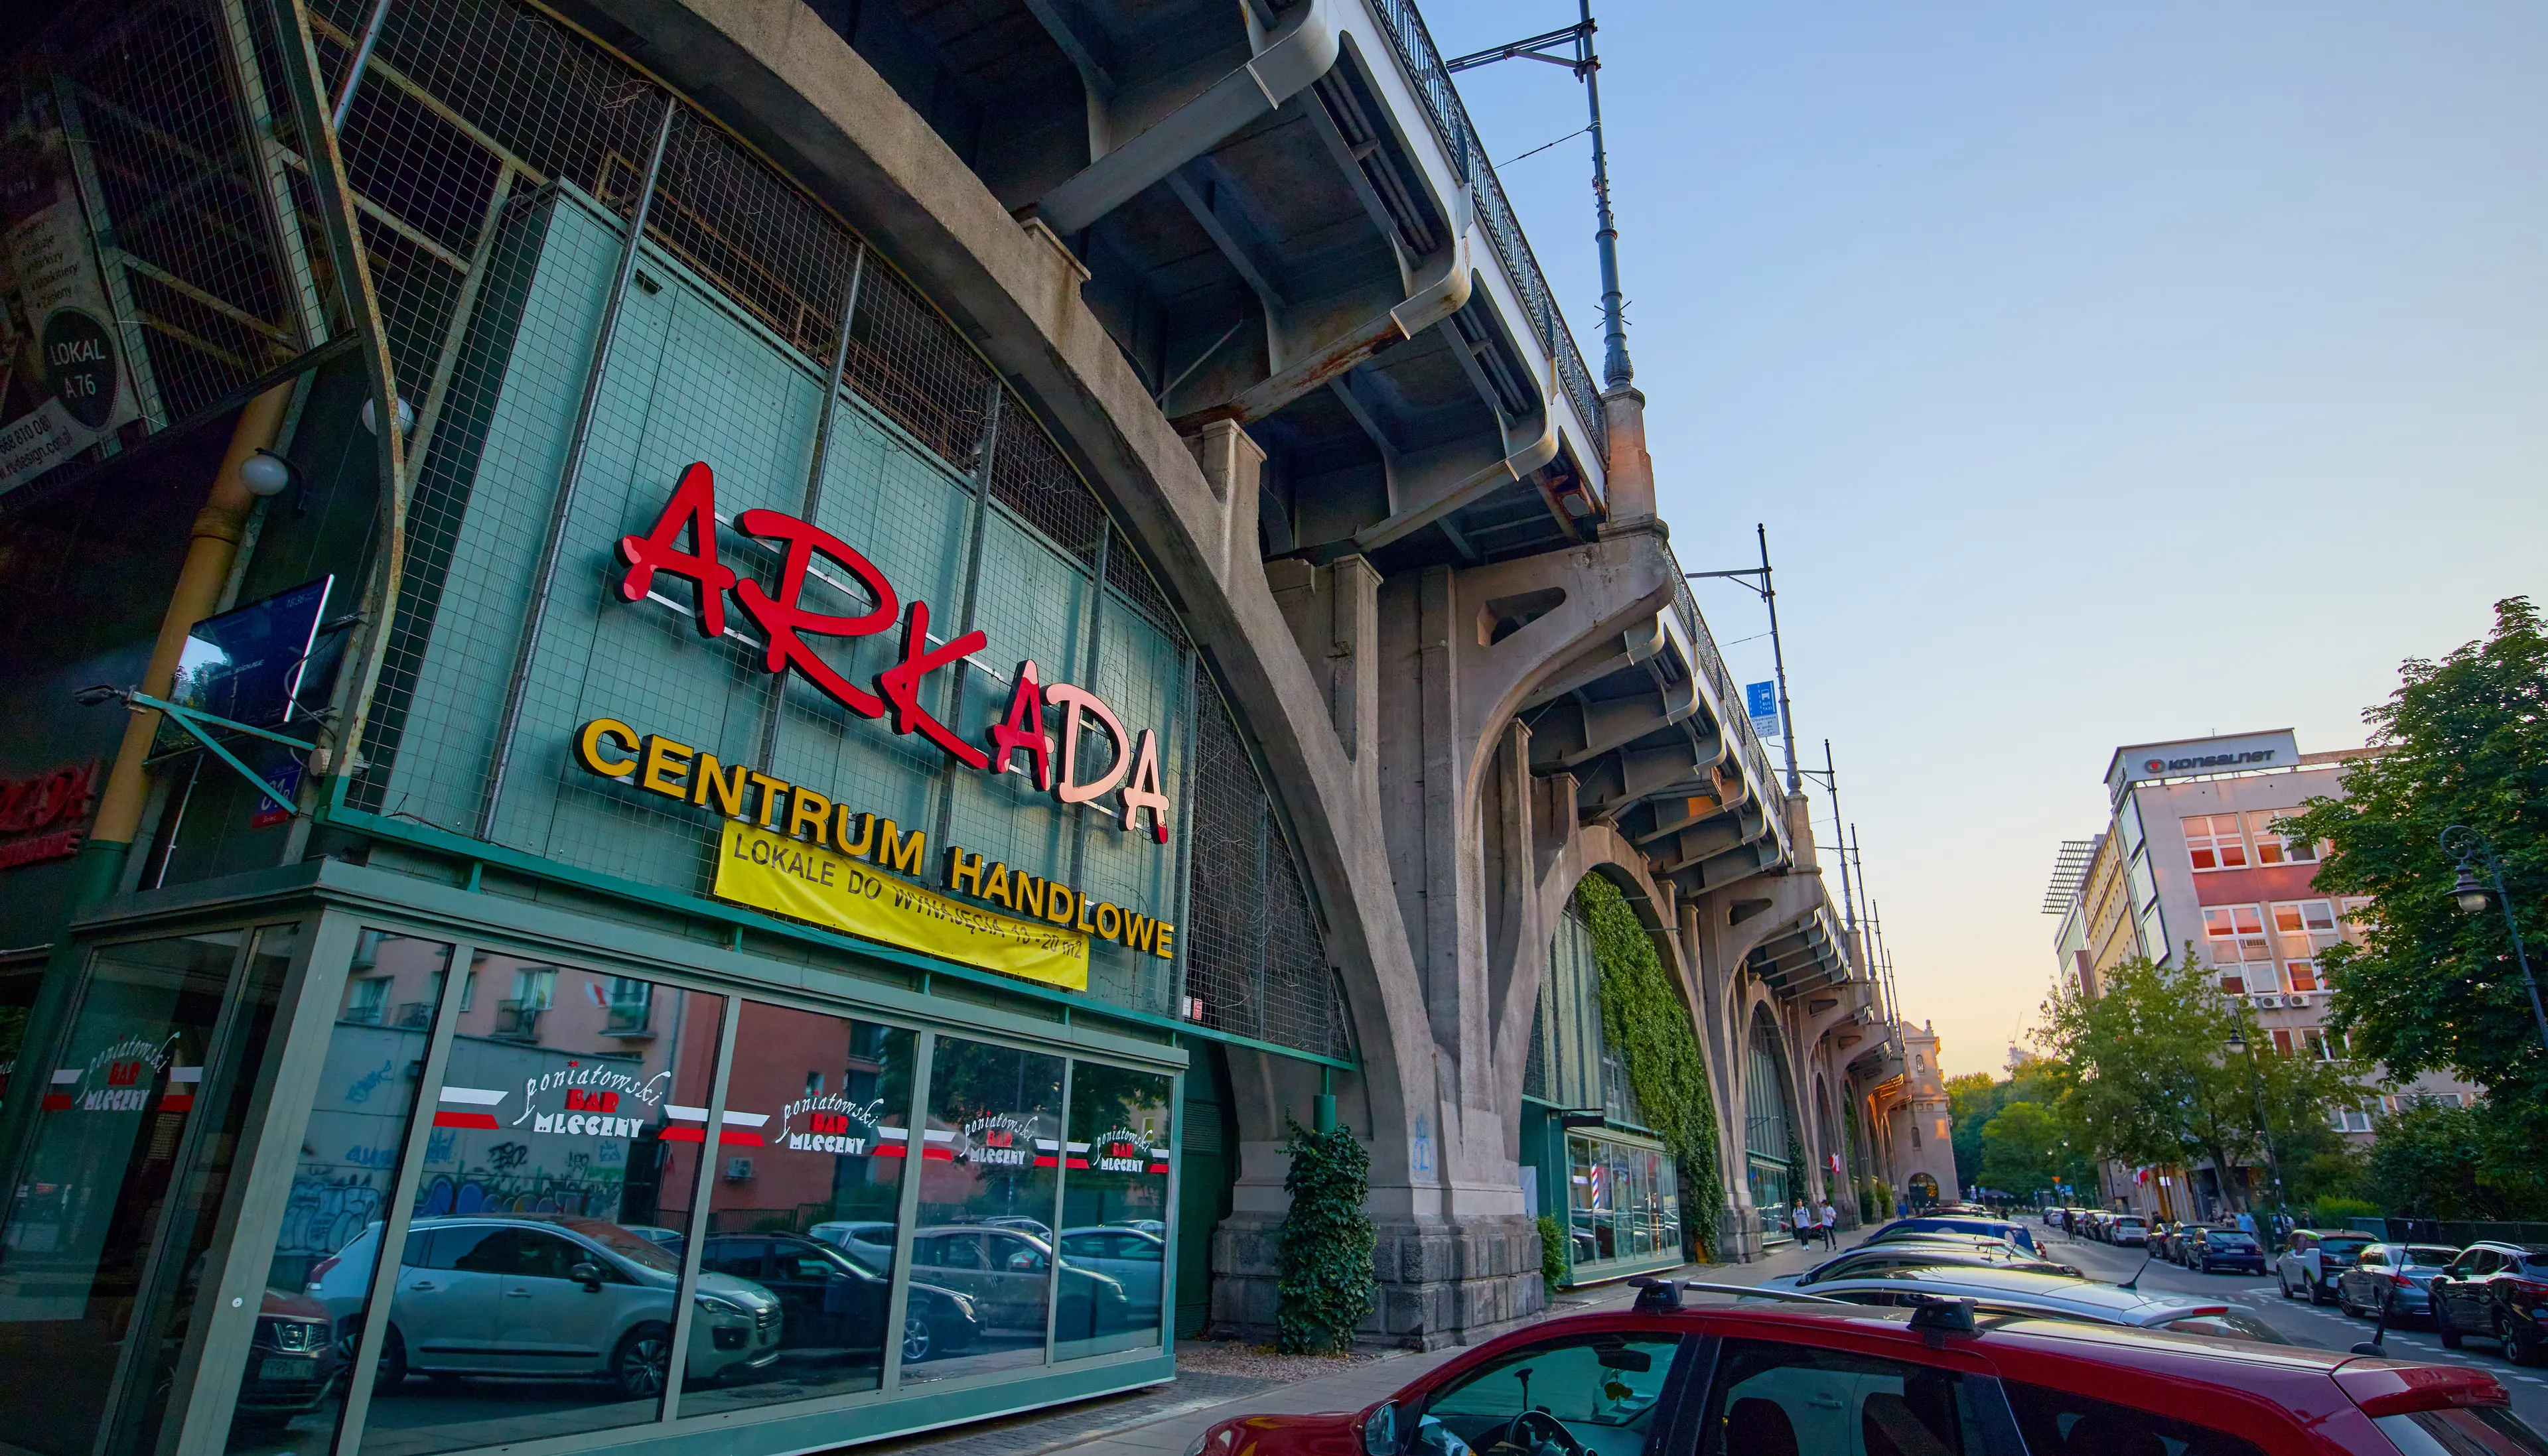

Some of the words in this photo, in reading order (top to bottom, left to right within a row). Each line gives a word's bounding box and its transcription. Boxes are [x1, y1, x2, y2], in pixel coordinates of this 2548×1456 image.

[50, 338, 106, 366] LOKAL
[614, 460, 1170, 845] ARKADA
[573, 717, 926, 877] CENTRUM
[942, 846, 1174, 959] HANDLOWE
[733, 832, 835, 888] LOKALE
[847, 869, 882, 900] DO
[891, 884, 1006, 938] WYNAJĘCIA
[1011, 924, 1030, 945] 13
[1041, 933, 1060, 953] 20
[1062, 939, 1082, 959] m2
[513, 1060, 672, 1126] poniatowski
[565, 1089, 619, 1112] BAR
[774, 1090, 884, 1144] poniatowski
[810, 1113, 849, 1134] BAR
[959, 1110, 1038, 1158] poniatowski
[987, 1130, 1013, 1148] BAR
[1093, 1124, 1153, 1166] poniatowski
[1111, 1142, 1133, 1158] BAR
